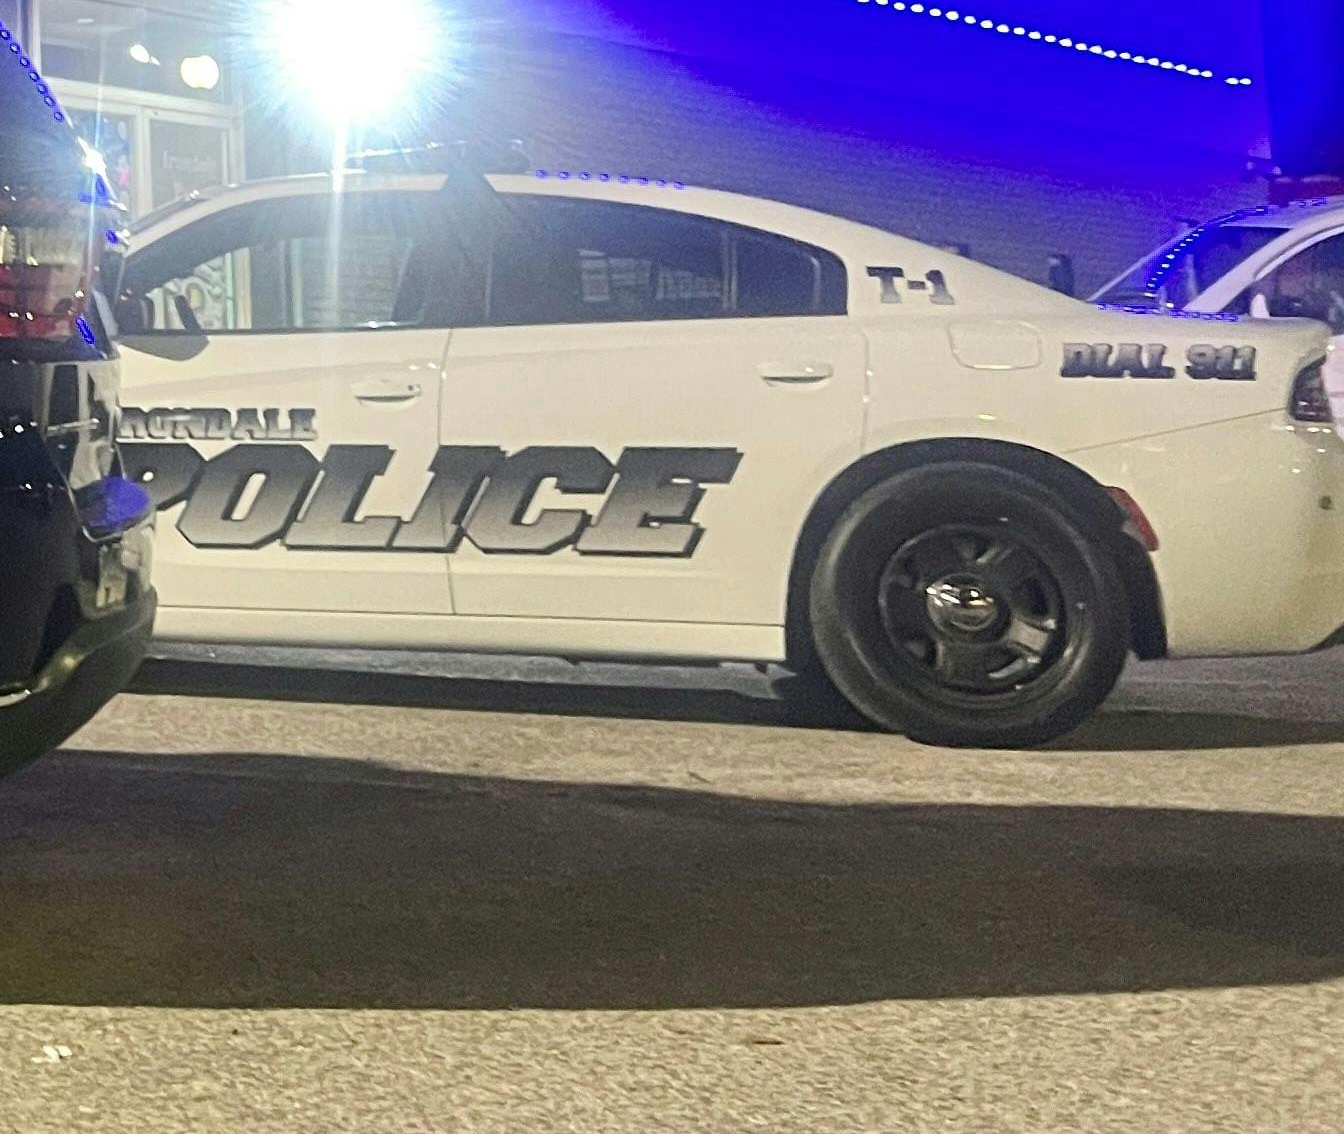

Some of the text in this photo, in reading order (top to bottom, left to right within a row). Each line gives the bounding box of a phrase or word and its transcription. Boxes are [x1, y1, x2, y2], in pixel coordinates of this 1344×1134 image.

[867, 266, 955, 305] T-1
[1060, 343, 1257, 381] DIAL 911
[115, 407, 318, 441] RONDALE
